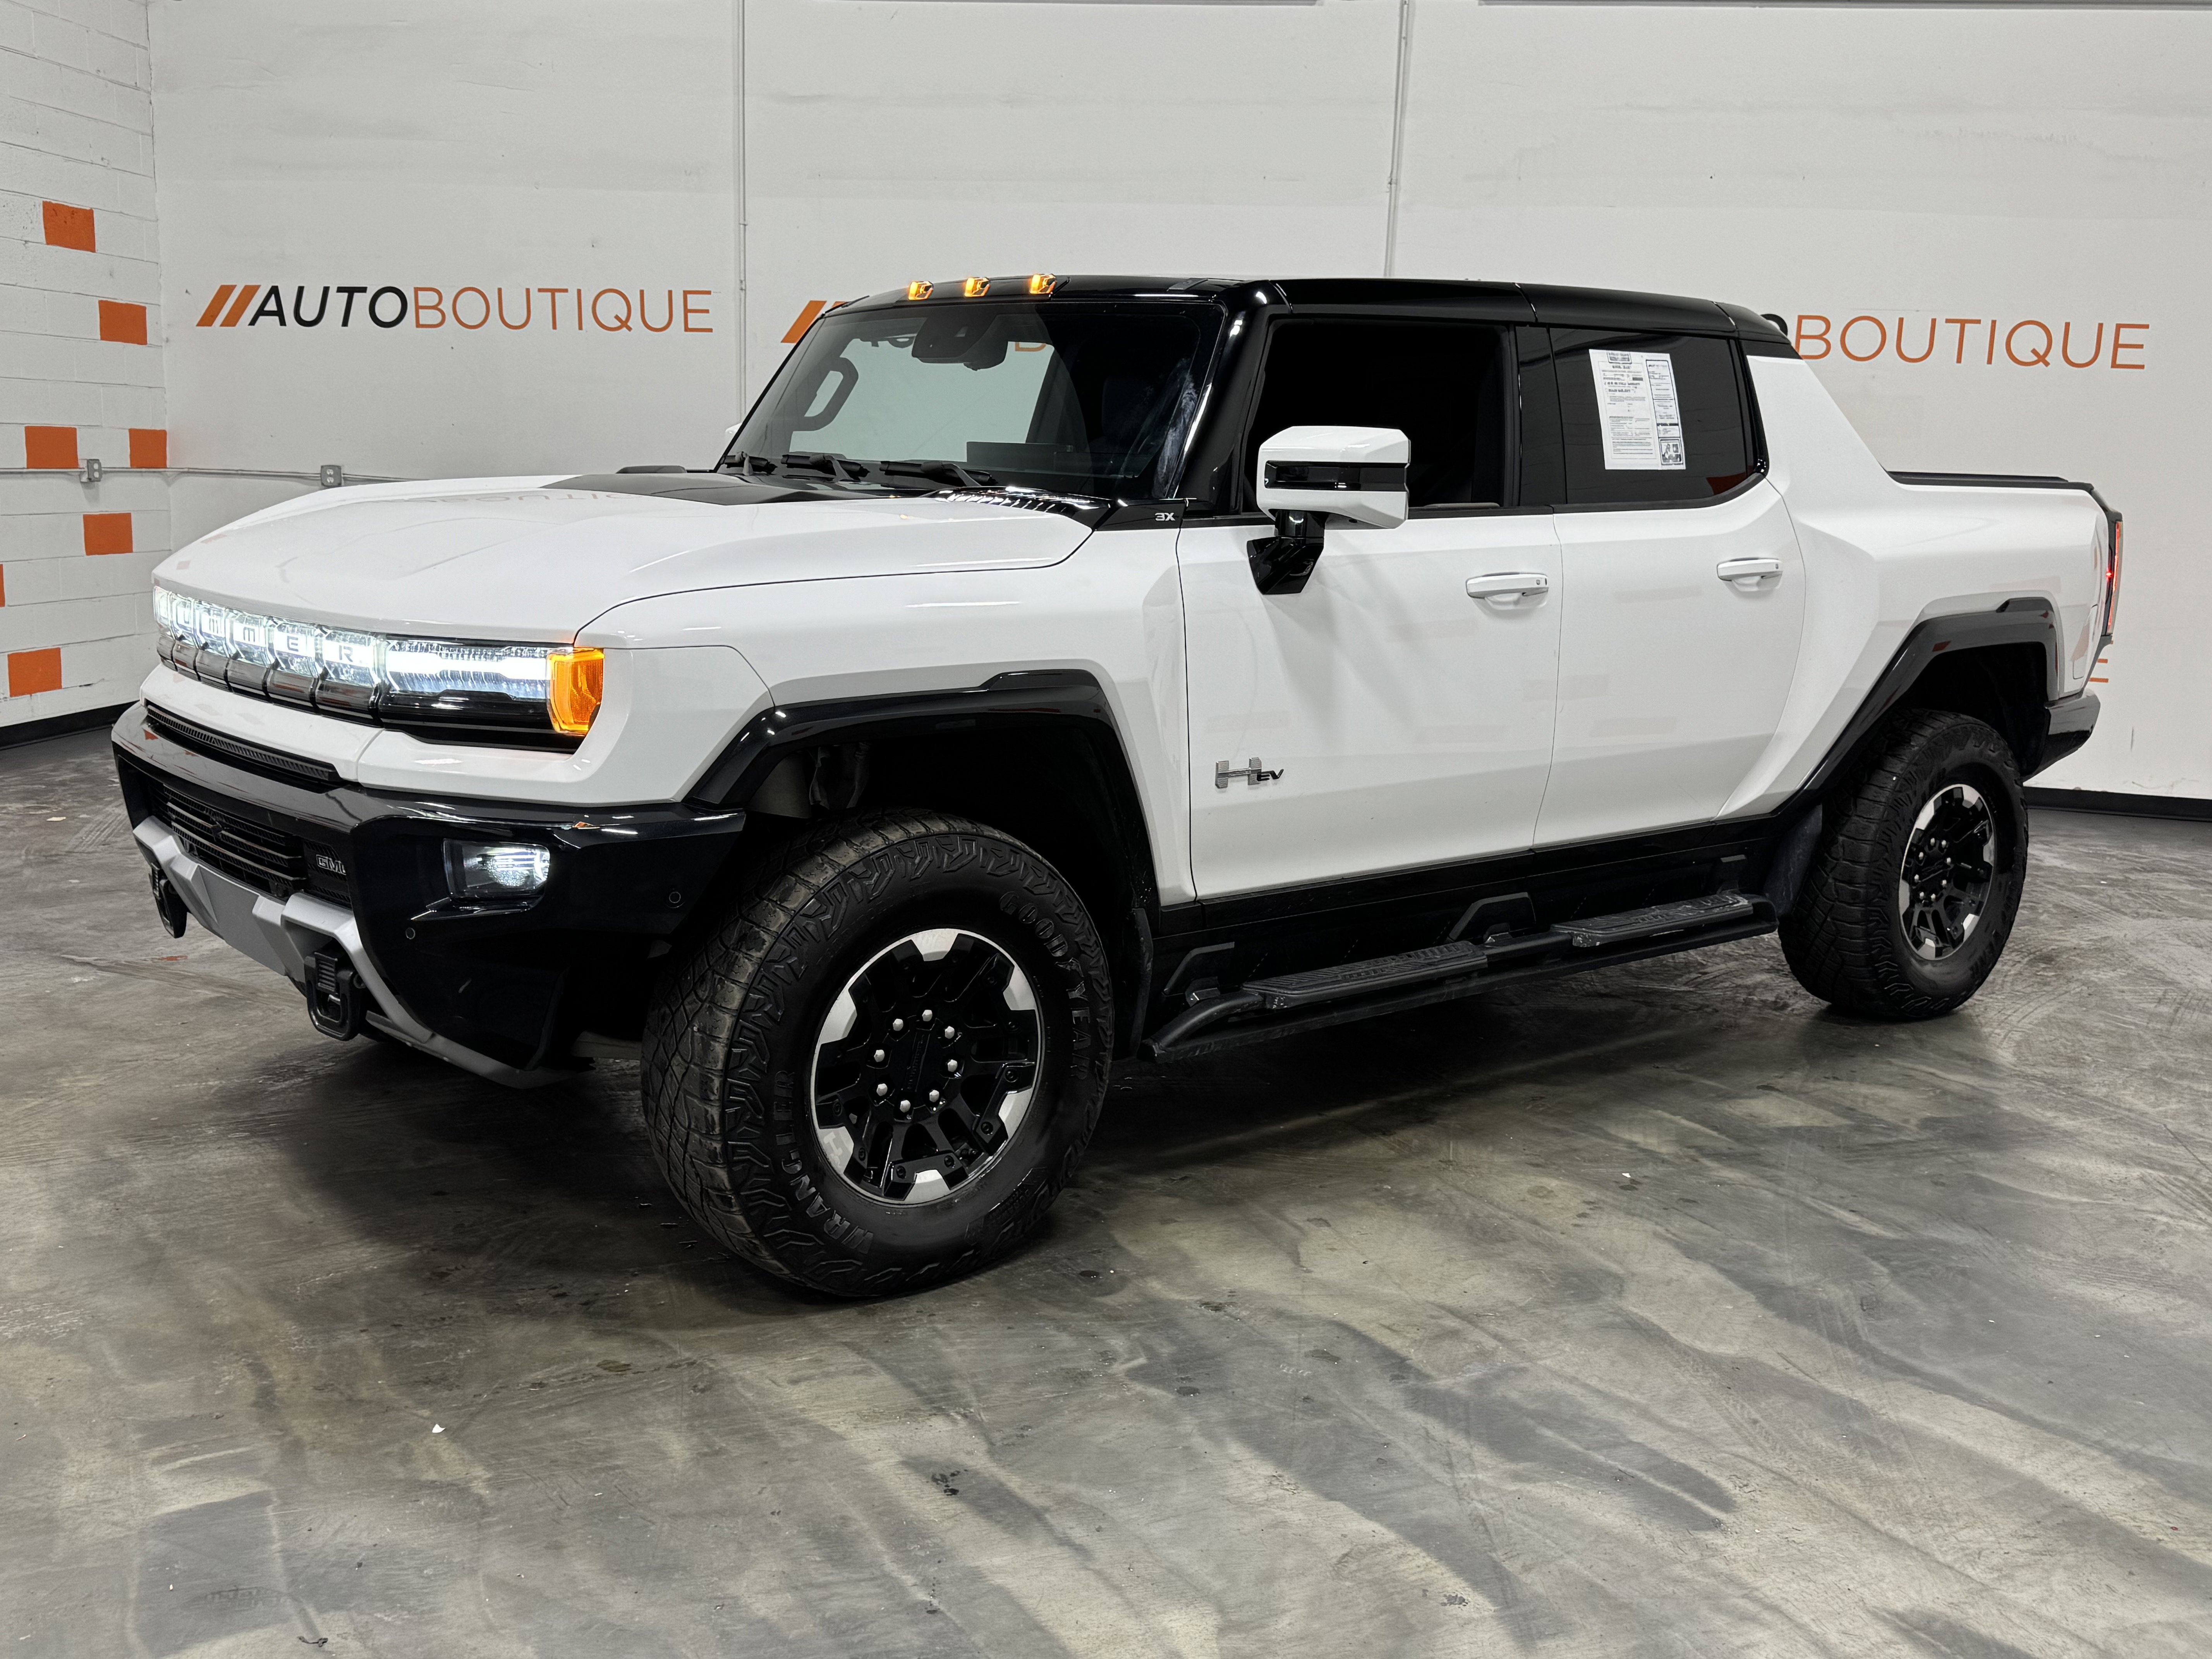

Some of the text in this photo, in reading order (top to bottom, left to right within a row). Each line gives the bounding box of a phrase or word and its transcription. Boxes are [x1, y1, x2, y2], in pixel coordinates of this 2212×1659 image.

[248, 285, 713, 333] AUTOBOUTIQUE
[1155, 512, 1175, 521] 3X
[162, 602, 353, 662] UMMER
[999, 891, 1091, 1080] GOODYEAR
[773, 1070, 874, 1254] WRANGLER
